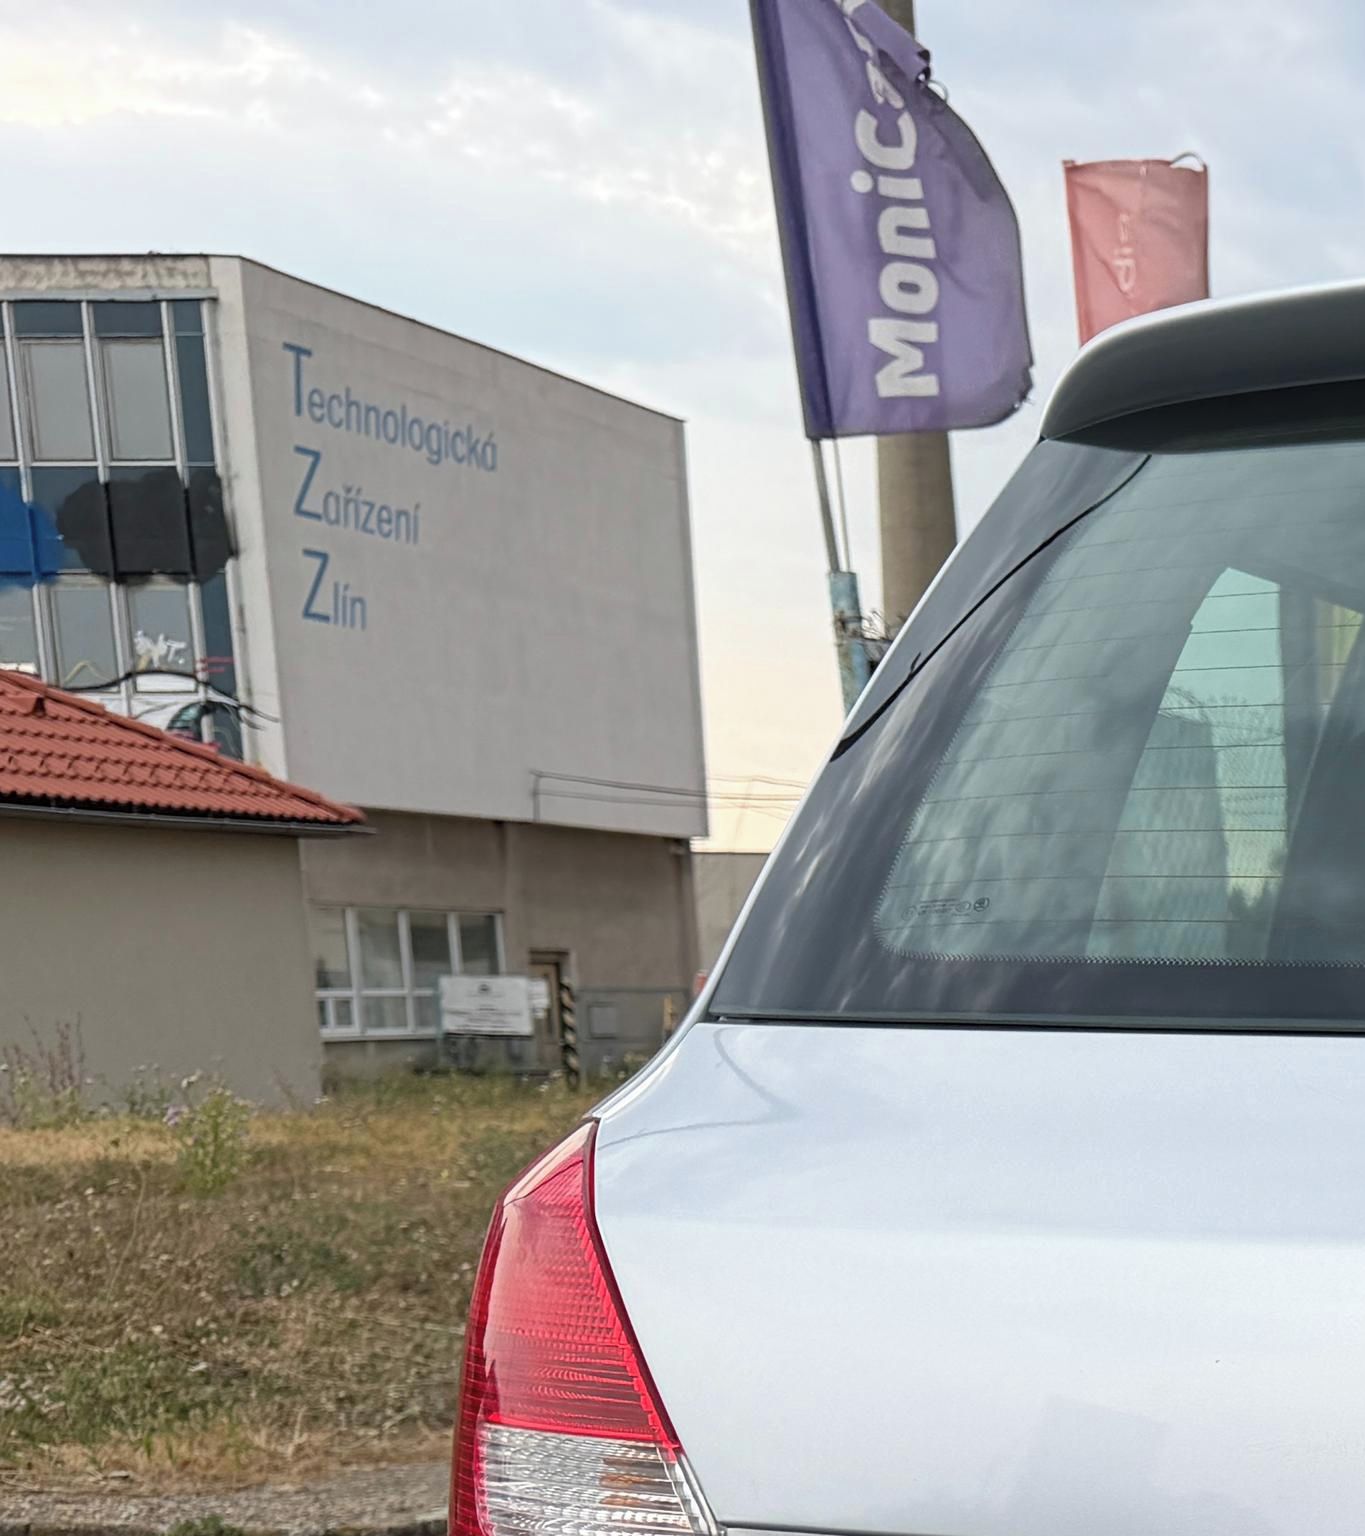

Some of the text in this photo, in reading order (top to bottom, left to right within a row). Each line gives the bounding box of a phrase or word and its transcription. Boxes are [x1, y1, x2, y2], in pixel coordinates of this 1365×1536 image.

[283, 342, 498, 472] Technologická
[293, 445, 421, 545] Zařízení
[302, 548, 367, 631] Zlín
